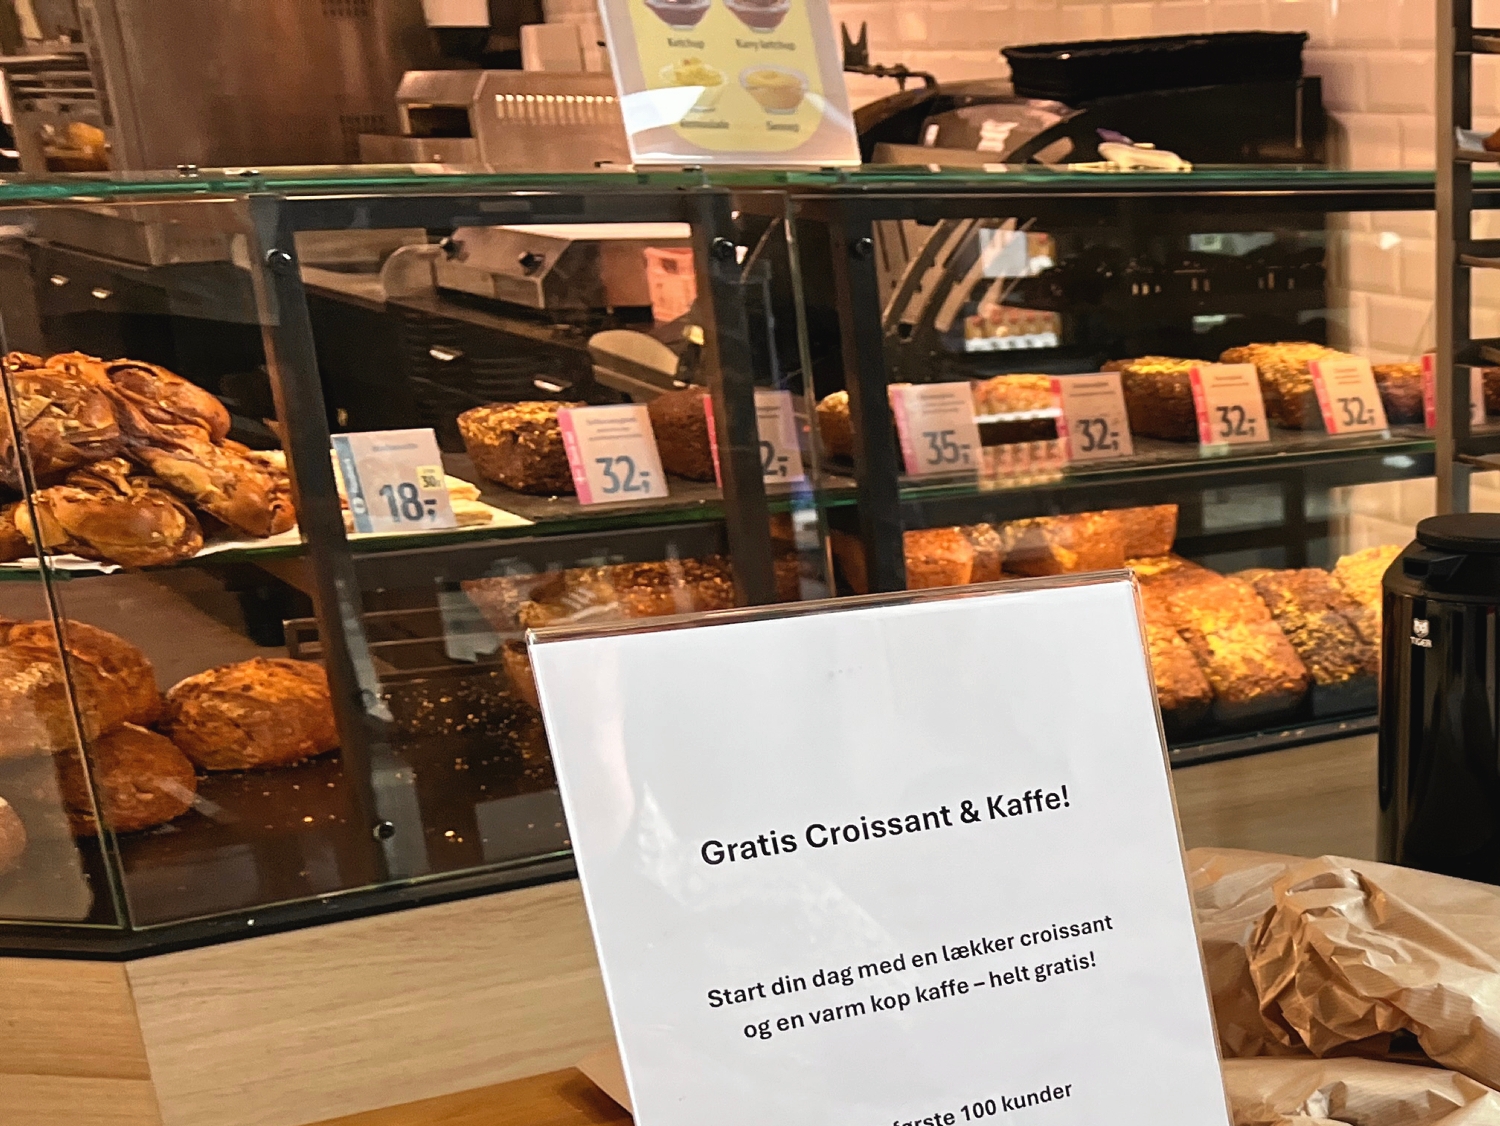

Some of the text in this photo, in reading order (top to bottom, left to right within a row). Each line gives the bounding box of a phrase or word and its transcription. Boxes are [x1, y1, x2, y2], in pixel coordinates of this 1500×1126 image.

[701, 785, 1071, 865] Gratis Croissant & Kaffe!
[707, 914, 1114, 1008] Start din dag med en lækker croissant
[743, 1019, 773, 1040] og
[776, 1013, 804, 1032] en
[809, 999, 866, 1025] varm
[870, 987, 911, 1014] kop
[915, 978, 969, 1004] kaffe
[989, 964, 1030, 989] helt
[1034, 951, 1097, 982] gratis!
[960, 1098, 997, 1121] 100
[1001, 1083, 1073, 1113] kunder
